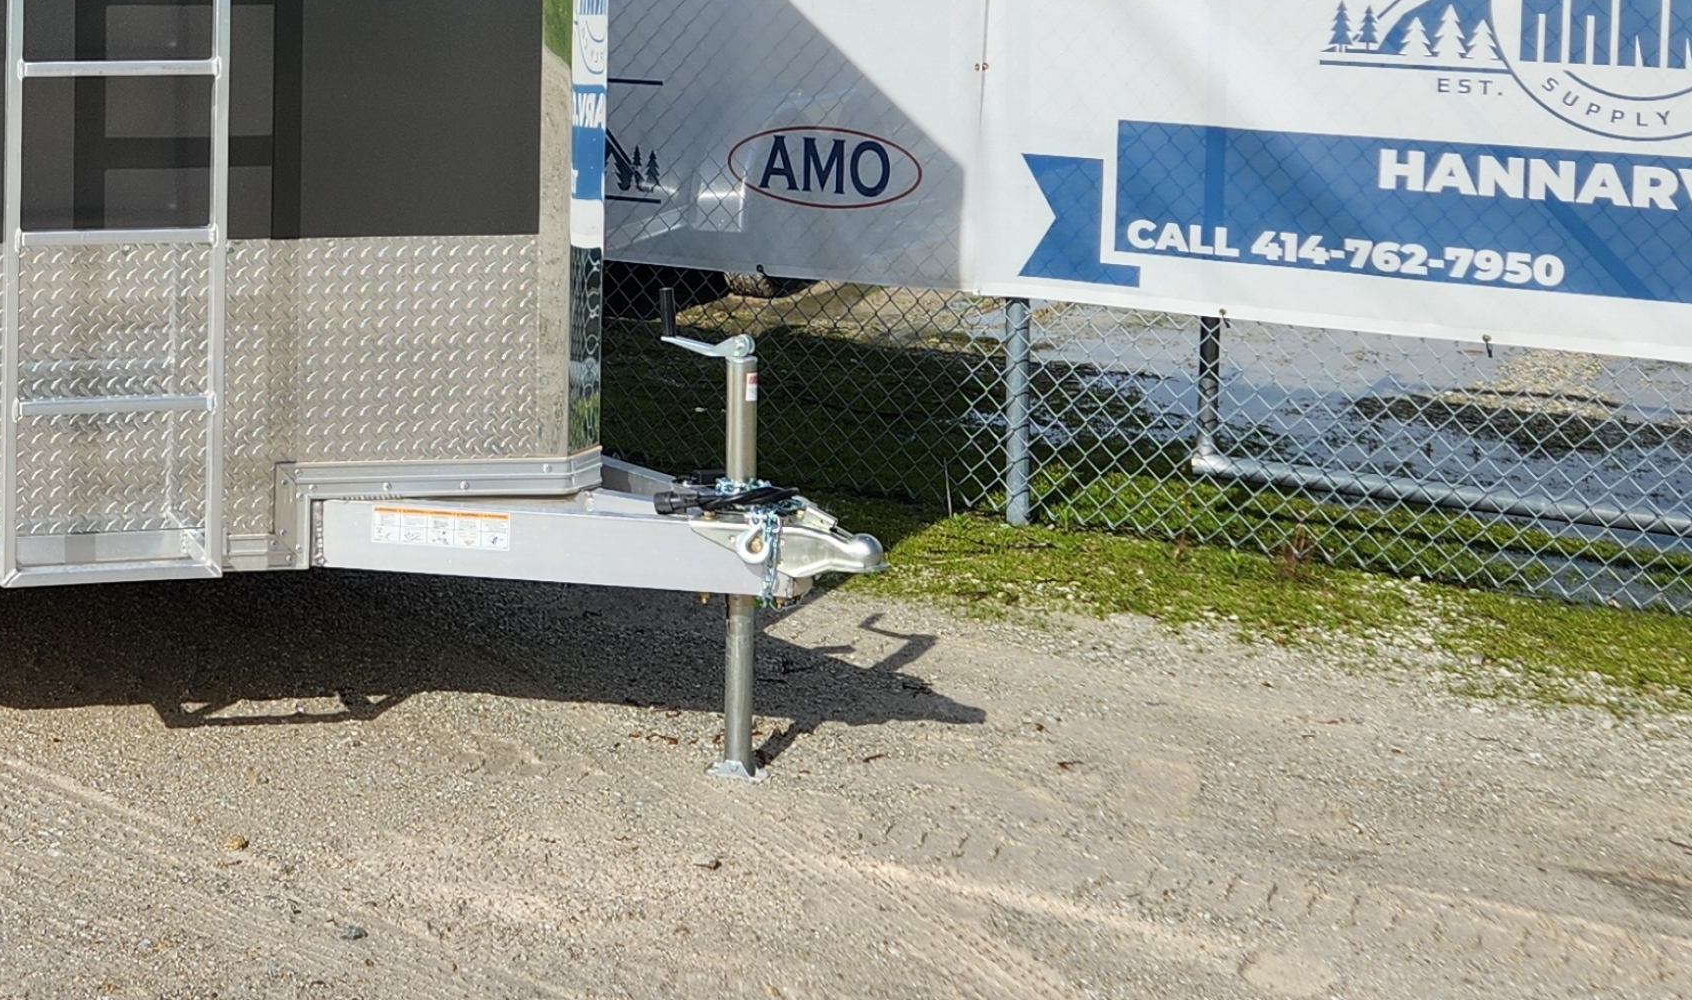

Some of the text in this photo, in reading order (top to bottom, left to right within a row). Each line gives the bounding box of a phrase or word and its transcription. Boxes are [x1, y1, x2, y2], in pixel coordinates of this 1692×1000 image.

[1437, 78, 1504, 96] EST.
[1541, 76, 1671, 127] SUPPLY
[758, 134, 891, 198] AMO
[1126, 219, 1565, 287] CALL 414-762-7950
